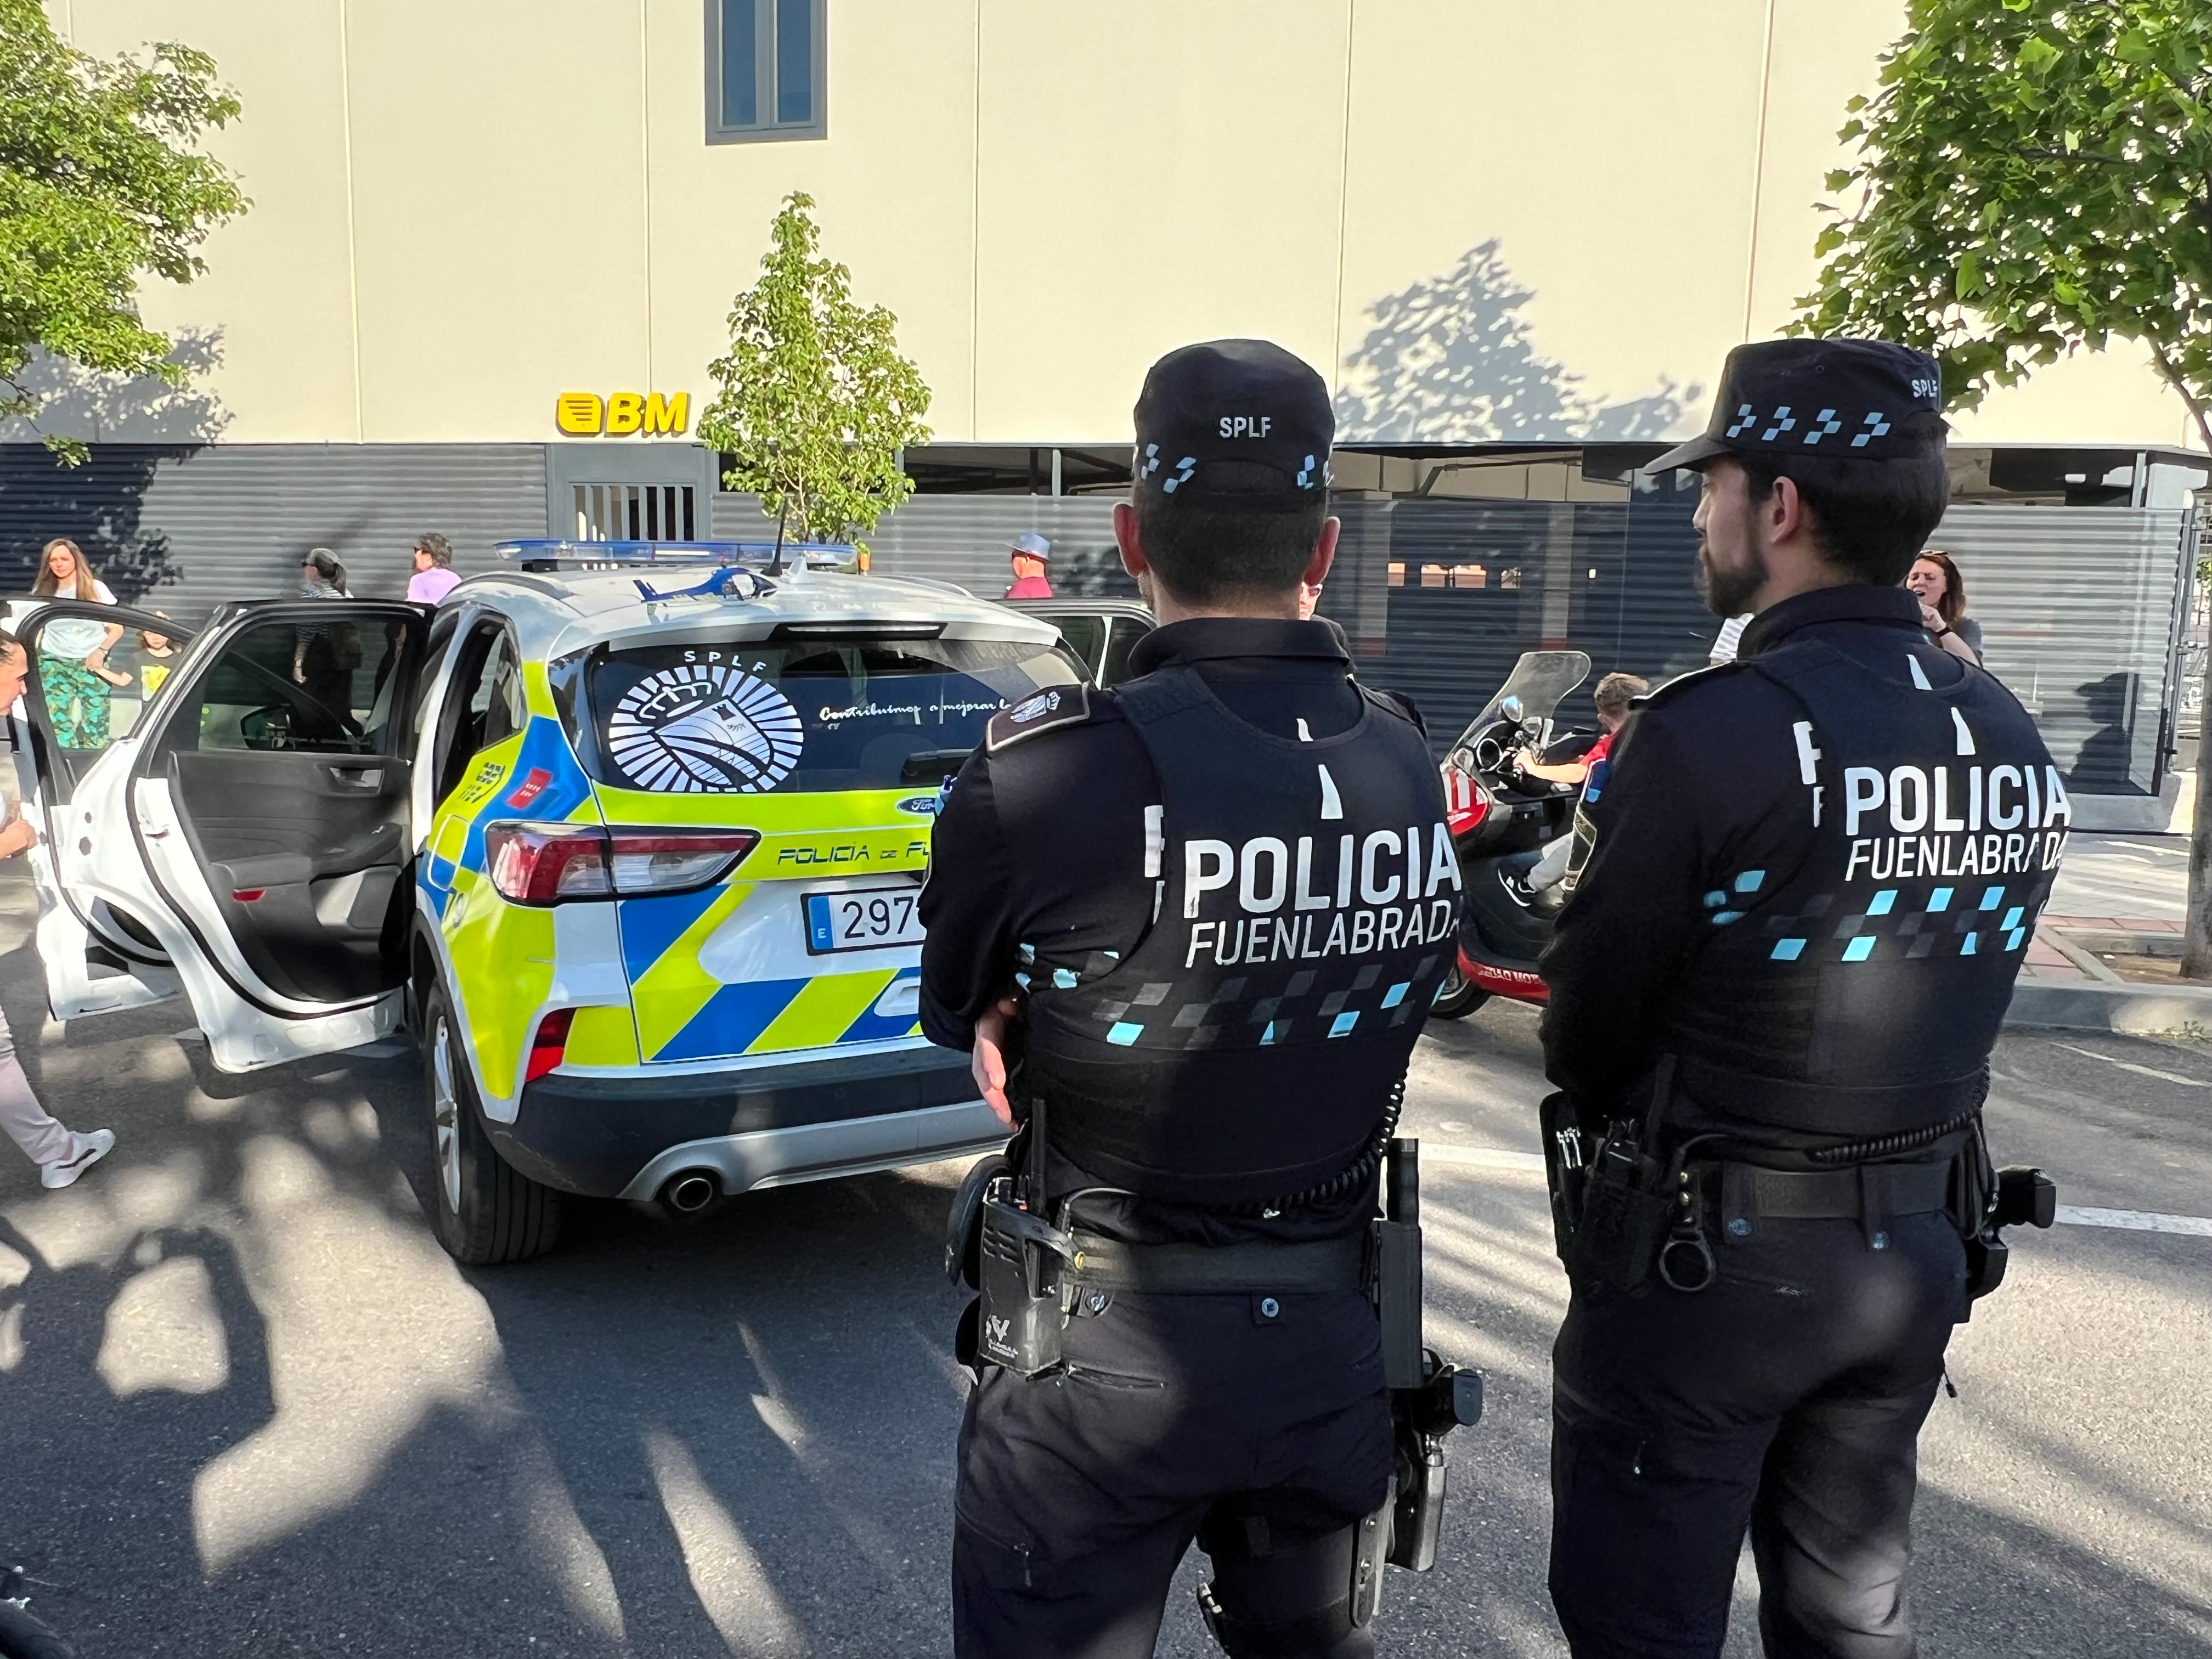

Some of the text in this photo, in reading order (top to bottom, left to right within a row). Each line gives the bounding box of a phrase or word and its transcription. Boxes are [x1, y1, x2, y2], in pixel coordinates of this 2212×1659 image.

[605, 392, 690, 436] BM
[1220, 416, 1271, 438] SPLF
[684, 651, 767, 672] SPLF
[911, 799, 935, 811] For
[1844, 765, 2072, 836] POLICIA
[1183, 822, 1462, 919] POLICIA
[817, 928, 826, 939] E
